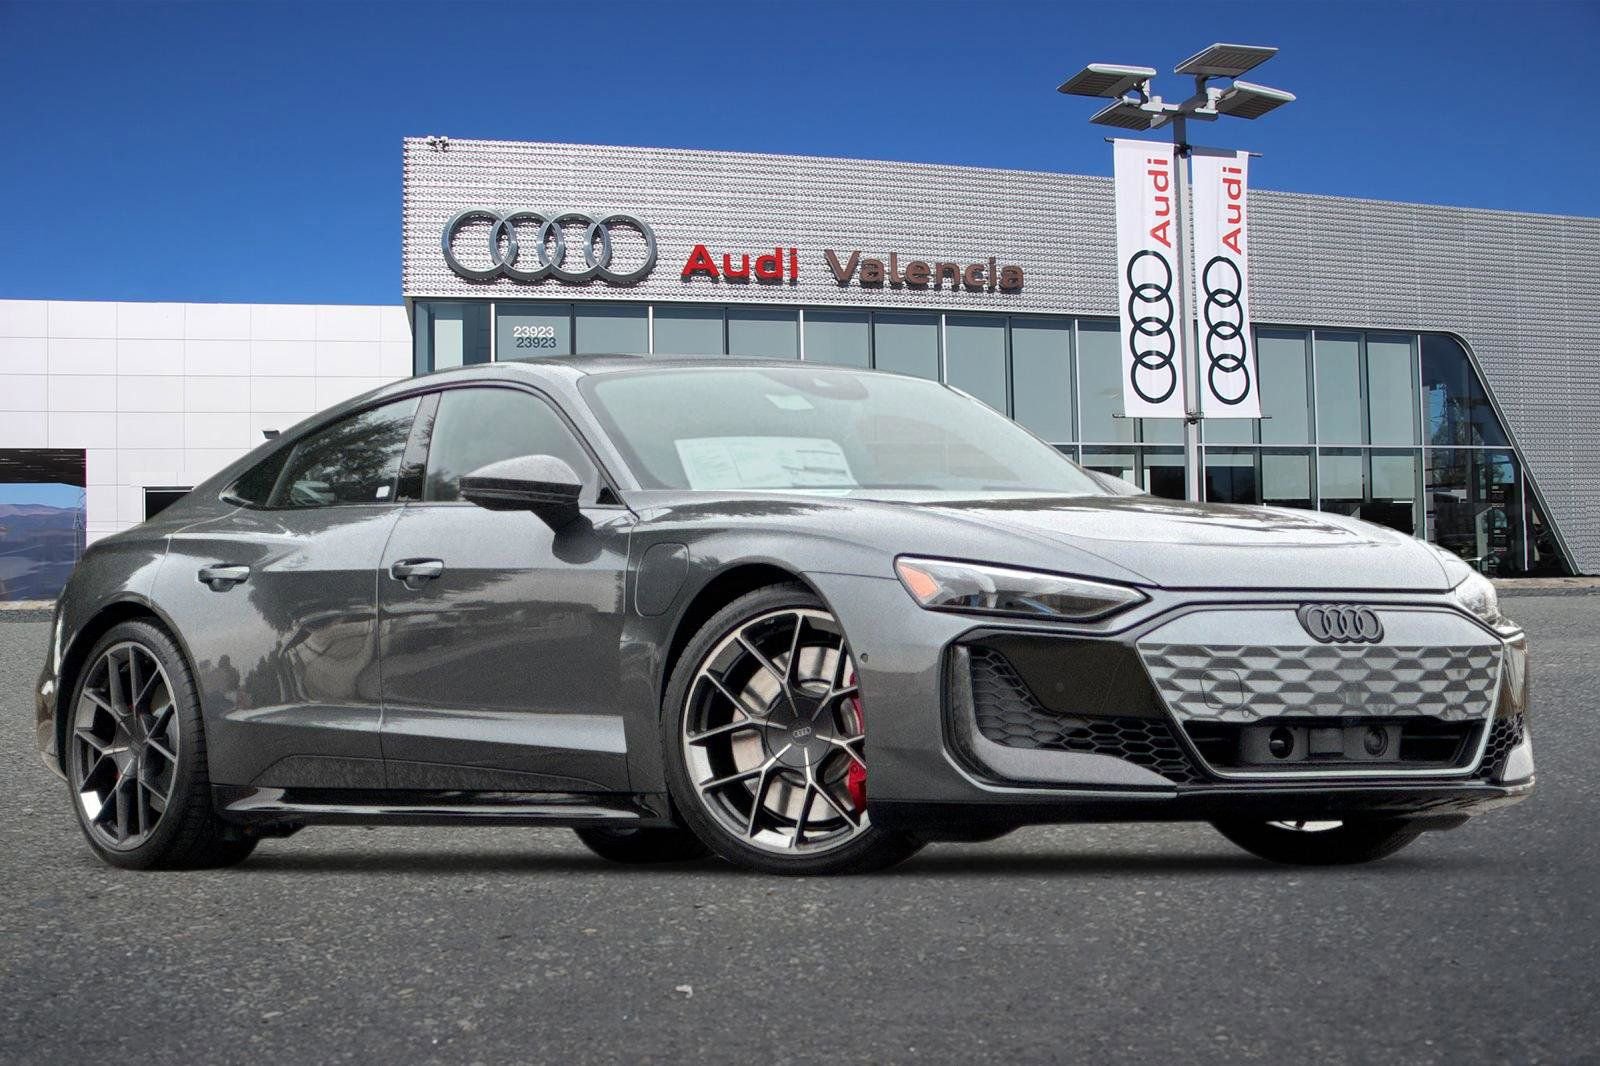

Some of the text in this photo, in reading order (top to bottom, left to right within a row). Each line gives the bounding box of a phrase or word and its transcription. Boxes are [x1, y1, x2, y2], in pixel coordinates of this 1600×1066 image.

[1147, 158, 1171, 248] Audi
[1222, 166, 1242, 255] Audi
[681, 244, 1025, 290] Audi Valencia
[513, 326, 554, 337] 23923
[516, 337, 556, 348] 23923
